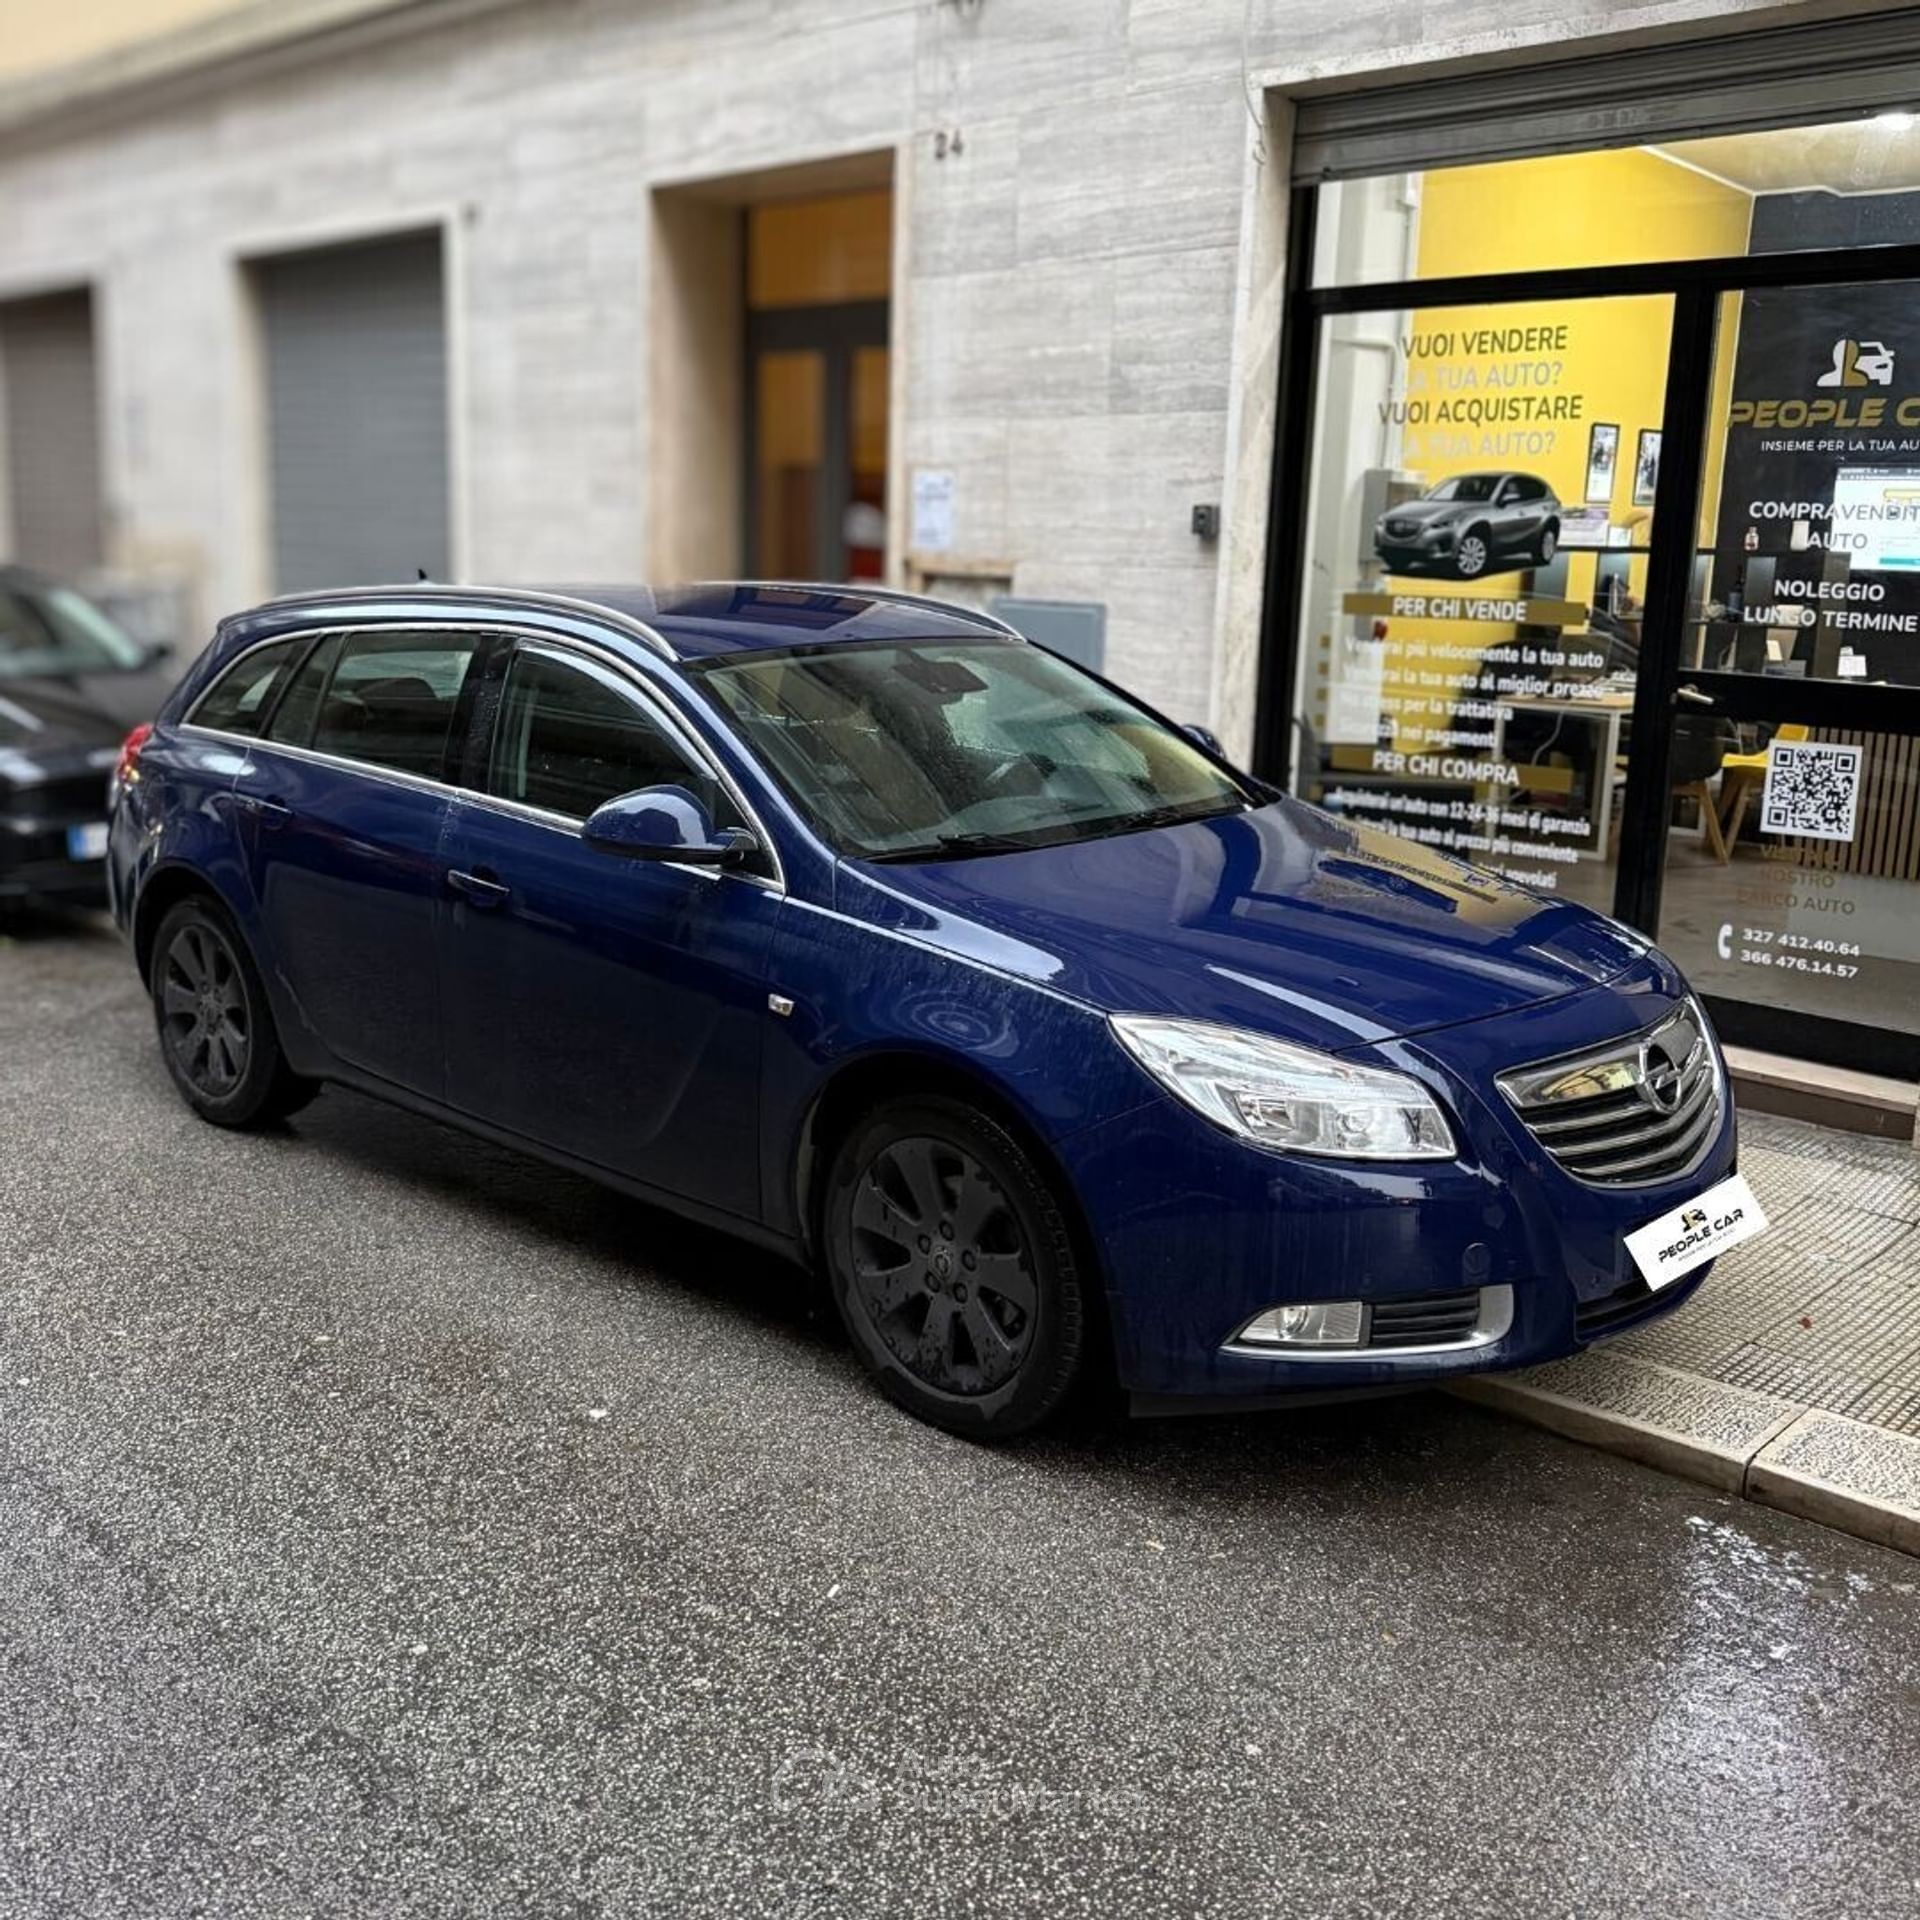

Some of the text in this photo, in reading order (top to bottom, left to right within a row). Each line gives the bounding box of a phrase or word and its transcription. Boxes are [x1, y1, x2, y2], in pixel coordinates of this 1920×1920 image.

[1401, 326, 1568, 358] VUOI VENDERE
[1436, 365, 1479, 390] TUA
[1485, 361, 1563, 388] AUTO?
[1379, 395, 1584, 427] VUOI ACQUISTARE
[1728, 398, 1889, 429] PEOPLE
[1478, 431, 1556, 457] AUTO?
[1761, 440, 1815, 452] INSIEME
[1818, 439, 1845, 451] PER
[1848, 439, 1865, 451] LA
[1869, 439, 1896, 451] TUA
[1807, 532, 1868, 550] AUTO
[1774, 579, 1885, 601] NOLEGGIO
[1391, 597, 1527, 621] PER CHI VENDE
[1744, 606, 1919, 632] LUNGO TERMINE
[1522, 645, 1537, 663] la
[1540, 649, 1566, 666] tua
[1568, 652, 1604, 668] auto
[1445, 673, 1478, 689] auto
[1480, 672, 1495, 691] al
[1497, 674, 1549, 697] miglior
[1425, 728, 1499, 748] pagament
[1372, 752, 1521, 785] PER CHI COMPRA
[1542, 816, 1591, 836] garanzia
[1804, 897, 1855, 916] AUTO
[1742, 927, 1861, 957] 327 412.40.64
[1740, 949, 1859, 979] 366 476.14.57
